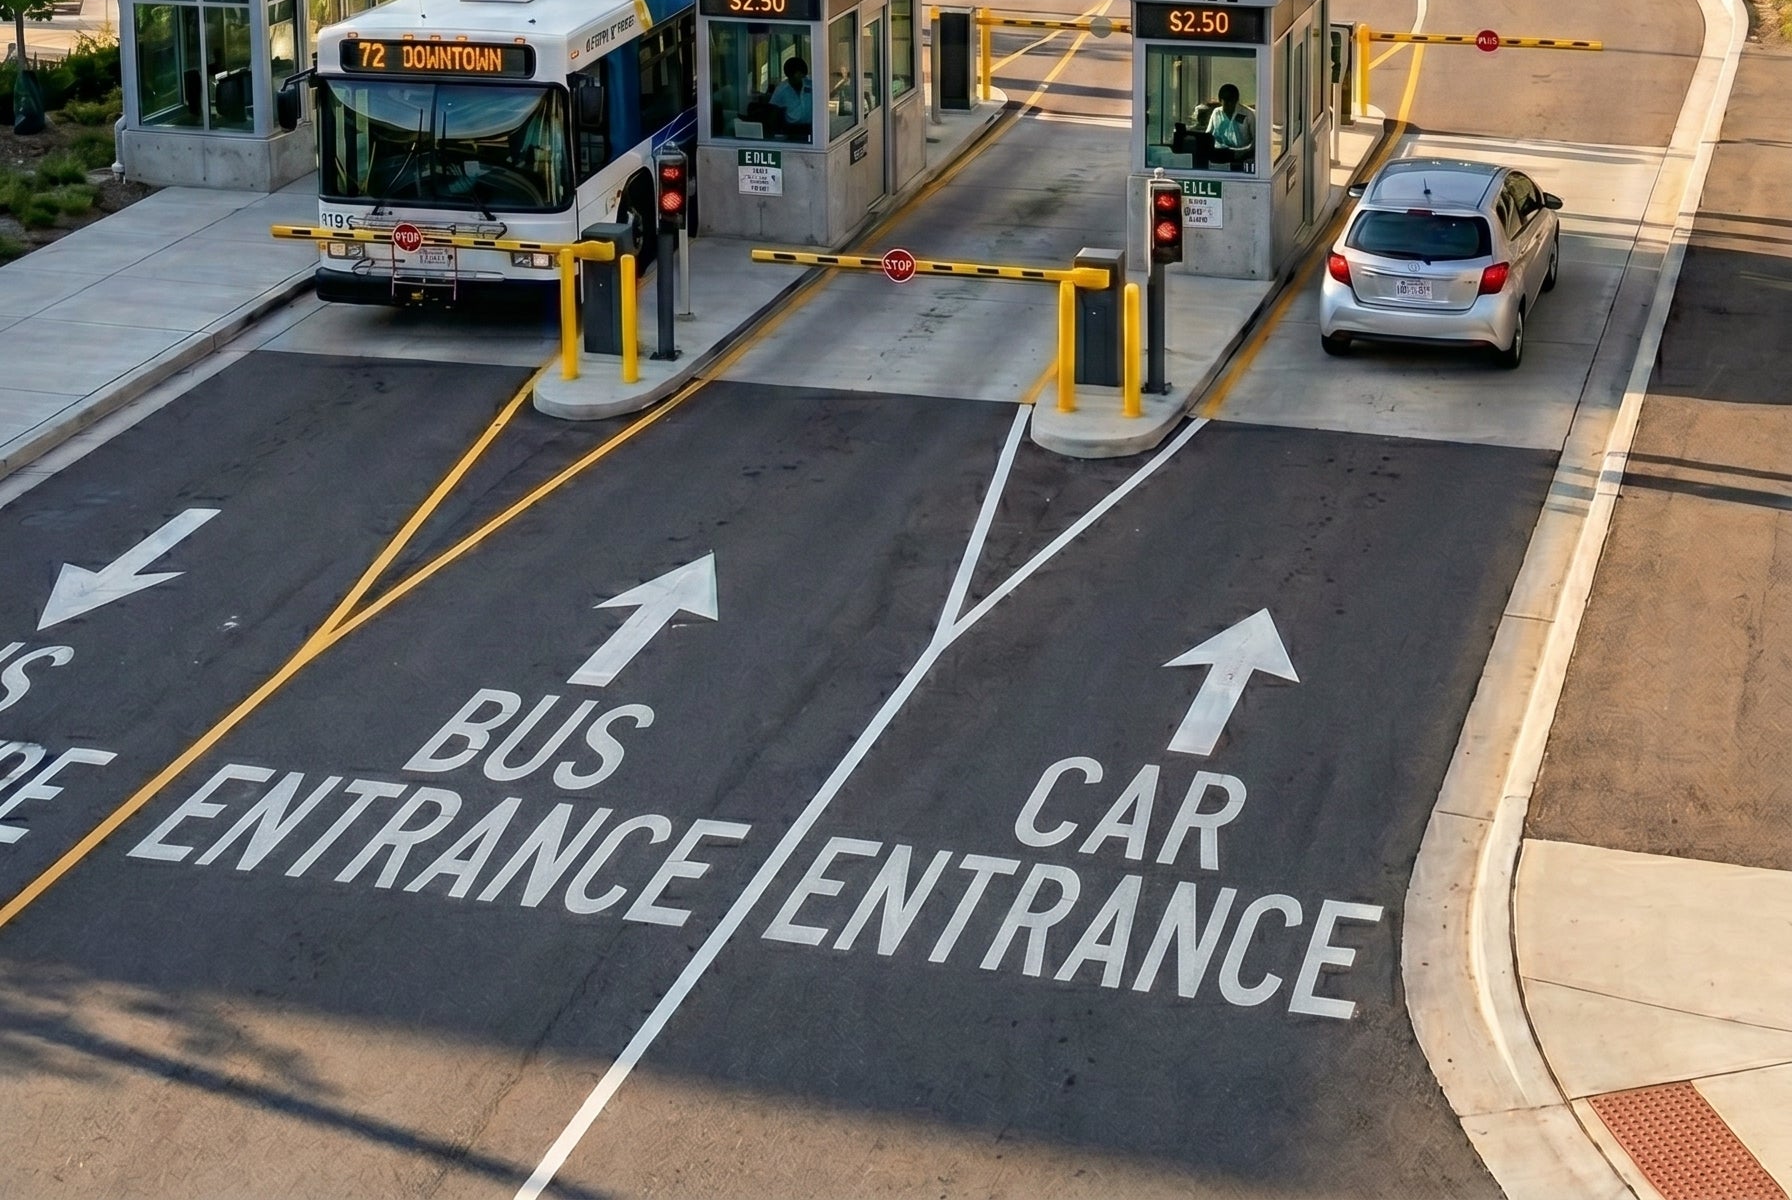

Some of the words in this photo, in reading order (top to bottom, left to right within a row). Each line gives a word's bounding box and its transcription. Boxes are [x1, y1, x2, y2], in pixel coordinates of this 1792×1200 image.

[358, 42, 385, 68] 72
[402, 45, 502, 72] DOWNTOWN
[885, 259, 912, 272] STOP
[402, 688, 655, 790] BUS
[126, 763, 753, 928] ENTRANCE
[1013, 756, 1247, 870] CAR
[762, 836, 1384, 1020] ENTRANCE
